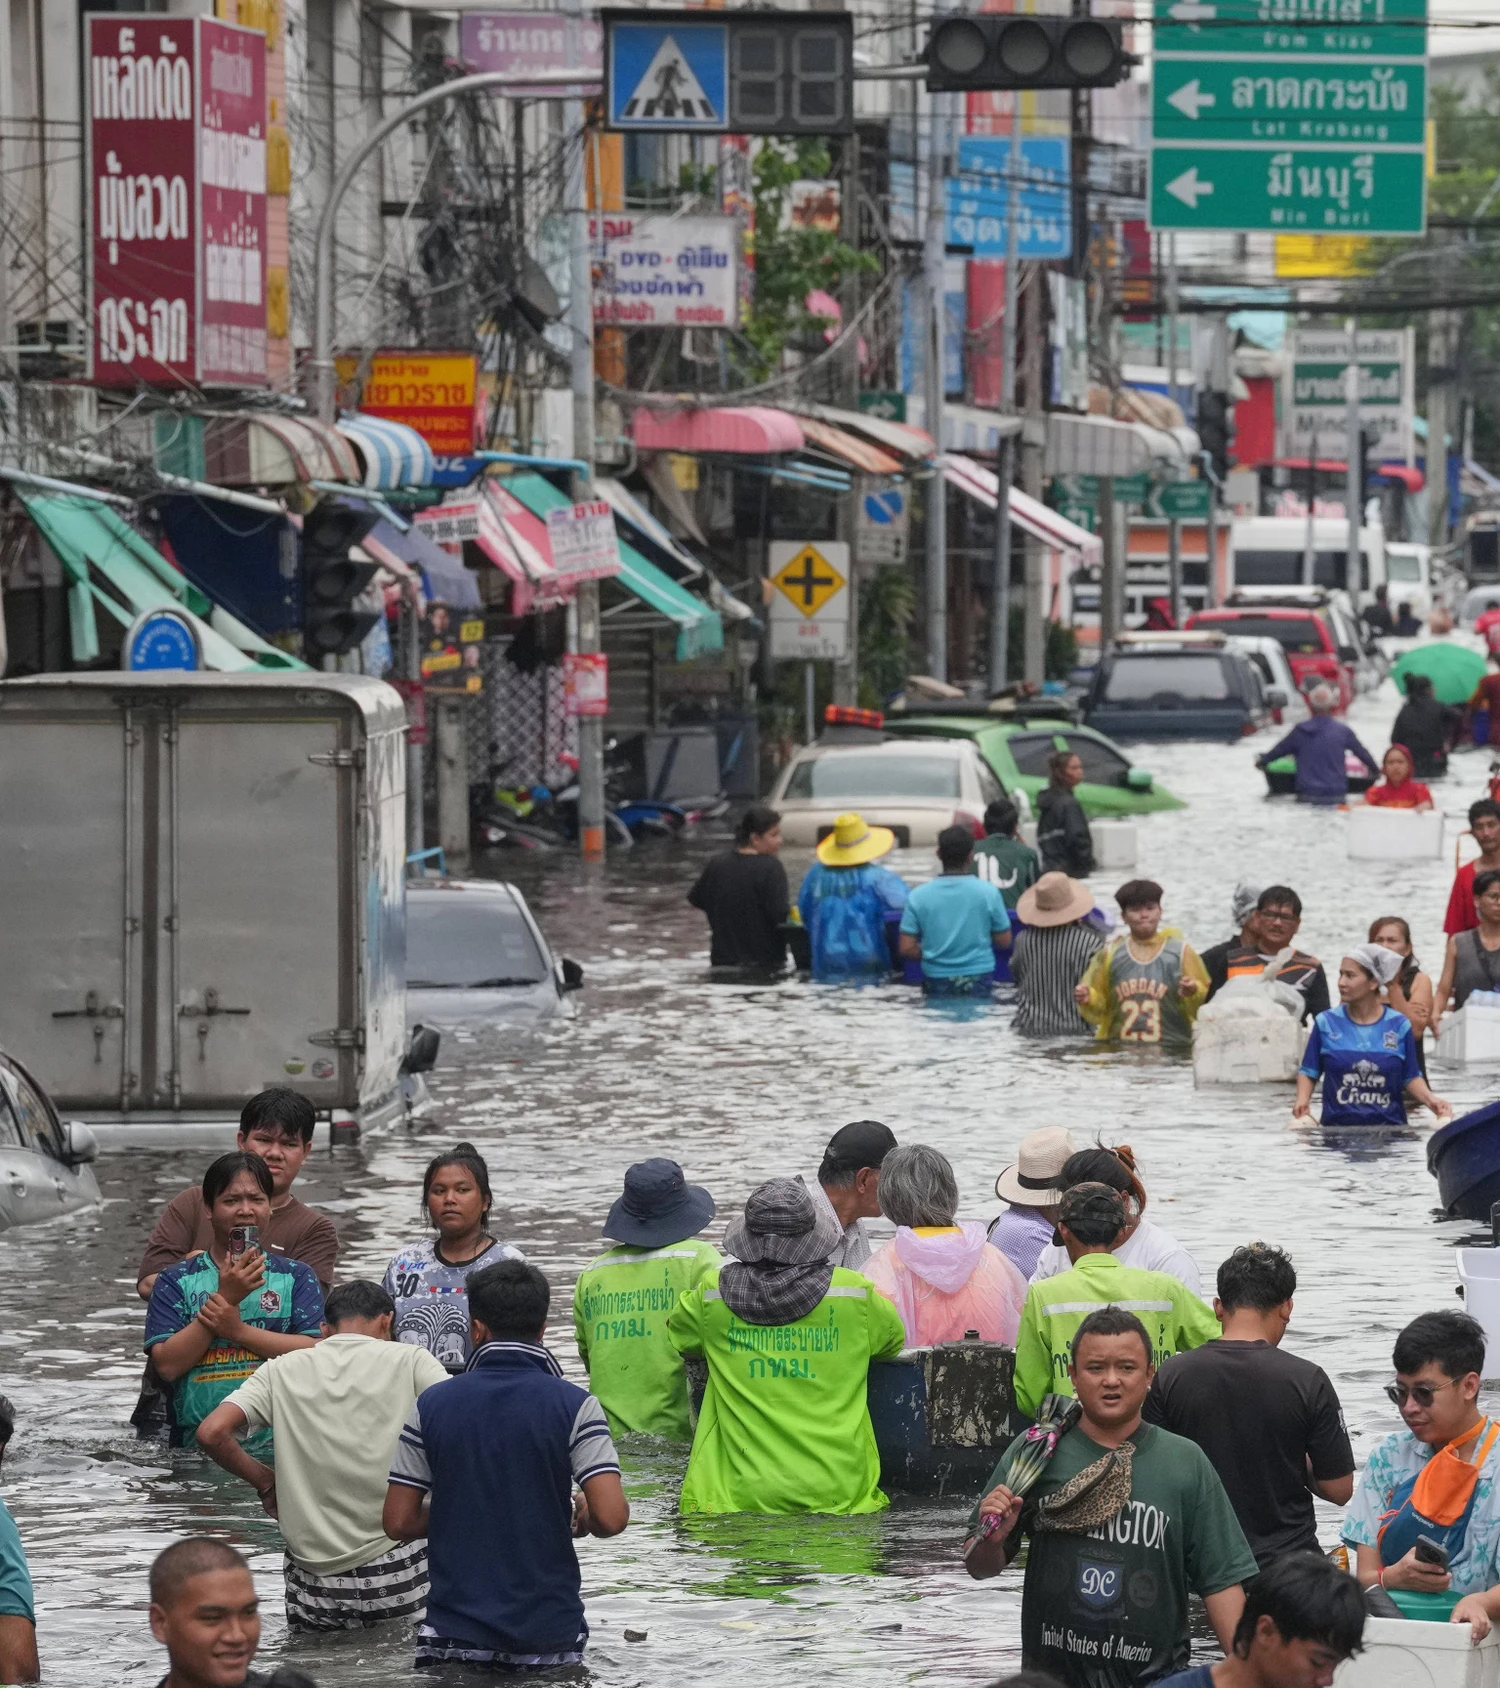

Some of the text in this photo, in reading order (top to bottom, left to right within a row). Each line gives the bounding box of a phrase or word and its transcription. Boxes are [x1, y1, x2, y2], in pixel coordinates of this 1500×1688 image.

[91, 26, 192, 120] เหล็กดัด
[1231, 67, 1408, 111] ลาดกระบัง
[1251, 120, 1389, 140] Lat Krabang
[1267, 152, 1374, 210] มีนบุรี
[99, 149, 189, 266] มุ้งลวด
[1271, 208, 1370, 225] Min Buri
[620, 251, 661, 267] DVD
[98, 296, 188, 365] กระจก
[1115, 977, 1168, 1002] JORDAN
[1120, 999, 1162, 1042] 23
[1336, 1086, 1391, 1109] Chang
[407, 1261, 428, 1271] ptt
[396, 1273, 420, 1298] 30
[596, 1317, 652, 1341] กทม.
[727, 1305, 840, 1353] สำนกการระบายน้ำ
[748, 1357, 817, 1379] กทม.
[1080, 1567, 1116, 1597] DC
[1066, 1629, 1098, 1657] States
[1102, 1634, 1115, 1659] of
[1115, 1635, 1153, 1662] America
